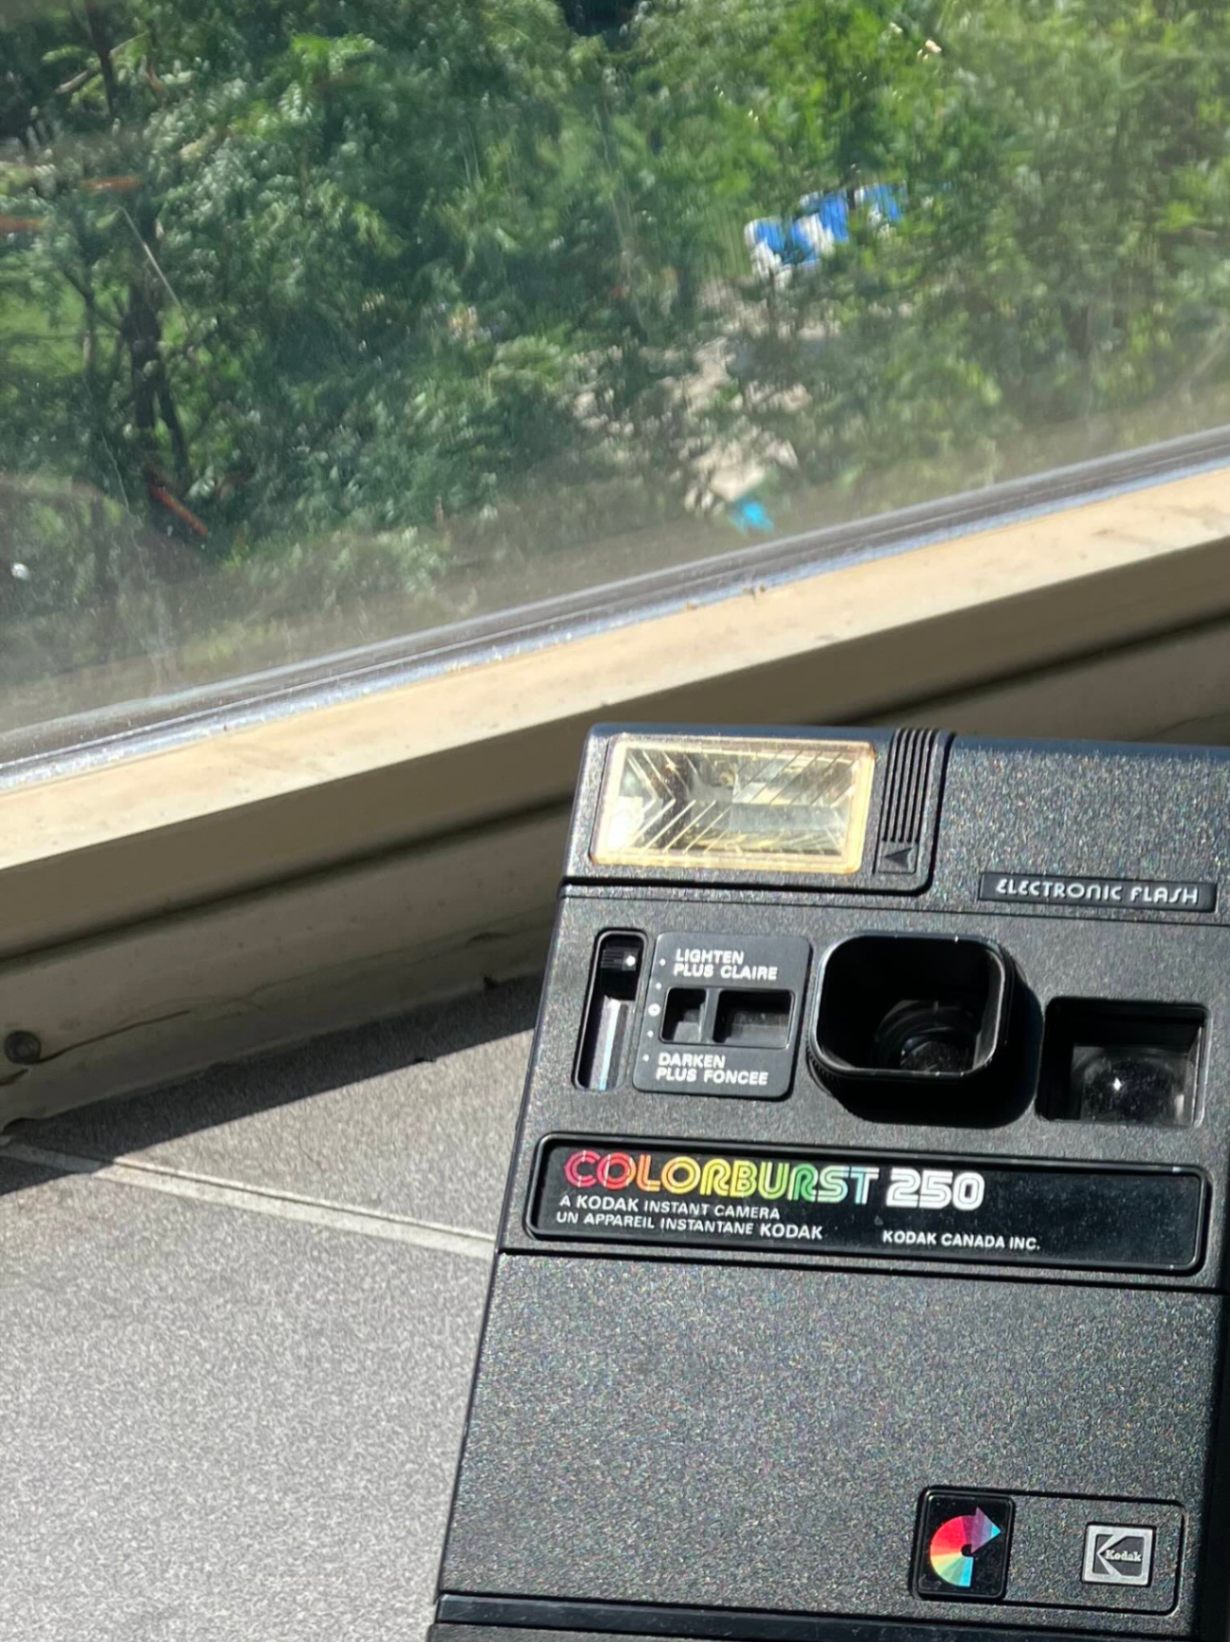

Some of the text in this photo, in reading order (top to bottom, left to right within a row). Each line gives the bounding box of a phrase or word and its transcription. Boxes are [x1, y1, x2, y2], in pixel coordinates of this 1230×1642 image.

[996, 878, 1198, 904] ELECTRONIC FLASH
[675, 948, 744, 965] LIGHTEN
[673, 963, 778, 981] PLUS CLAIRE
[658, 1052, 726, 1069] DARKEN
[656, 1067, 769, 1086] PLUS FONCEE
[563, 1150, 986, 1212] COLORBURST 250
[559, 1195, 780, 1221] A KODAK INSTANT CAMERA
[556, 1211, 823, 1241] UN APPAREIL INSTANTANE KODAK
[882, 1230, 1041, 1251] KODAK CANADA INC.
[1105, 1549, 1142, 1562] Kodak
